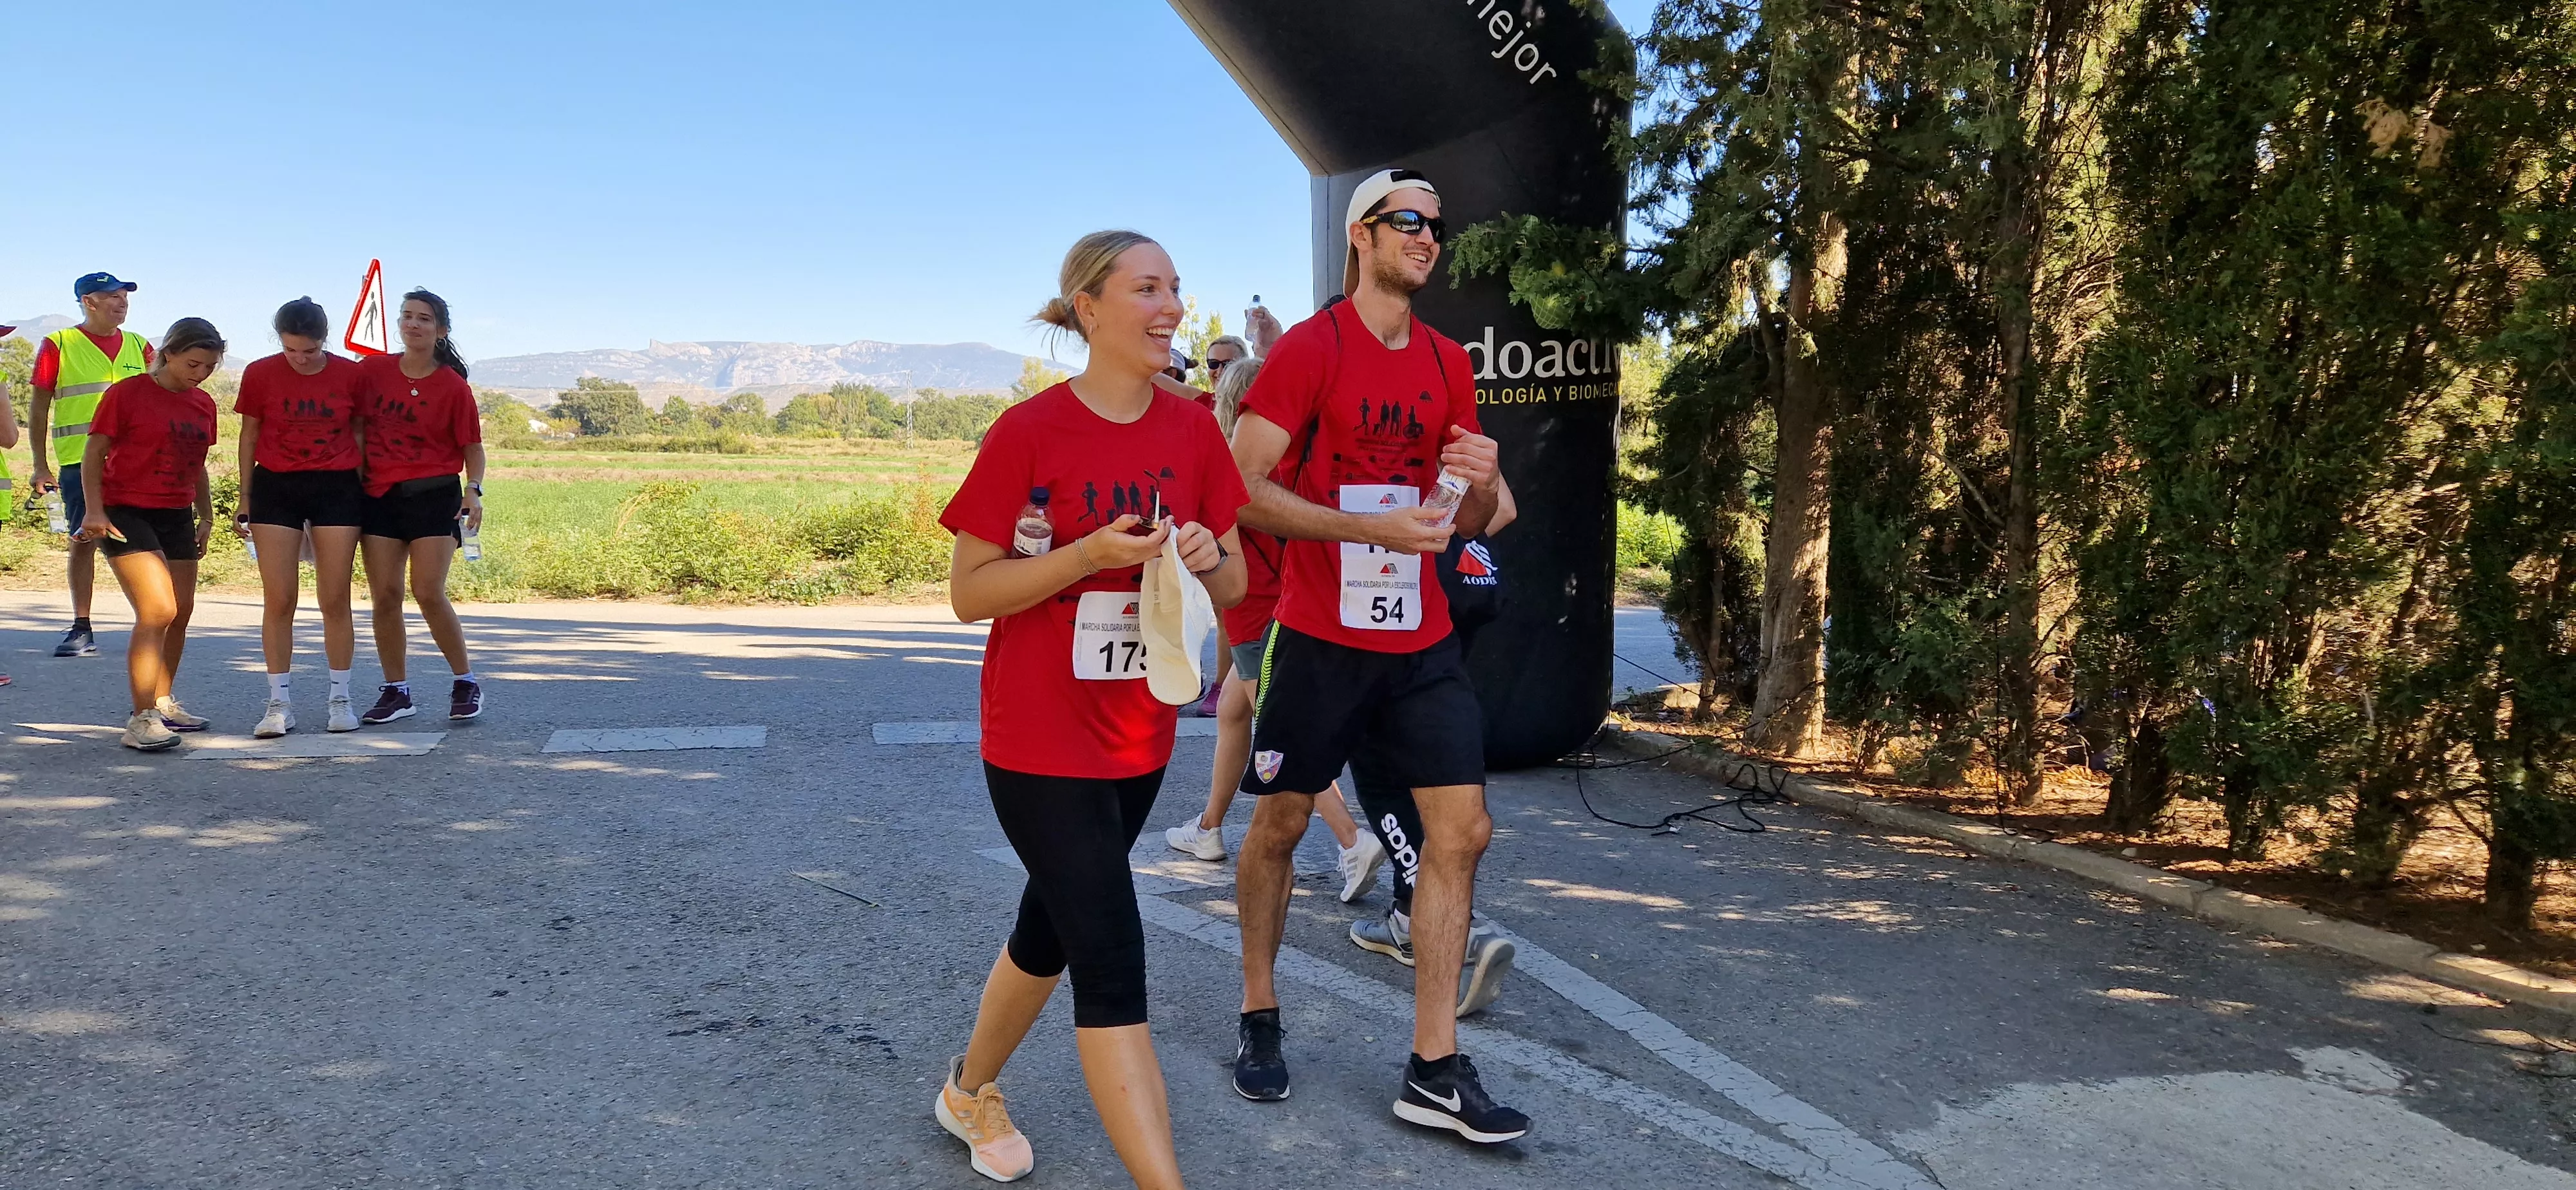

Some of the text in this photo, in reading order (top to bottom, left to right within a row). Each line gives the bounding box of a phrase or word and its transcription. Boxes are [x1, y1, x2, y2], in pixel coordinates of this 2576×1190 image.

[1554, 386, 1563, 402] Y
[1370, 596, 1404, 623] 54
[1082, 622, 1101, 631] MARCHA
[1101, 623, 1122, 632] SOLIDARIA
[1123, 623, 1132, 632] POR
[1132, 623, 1137, 632] LA
